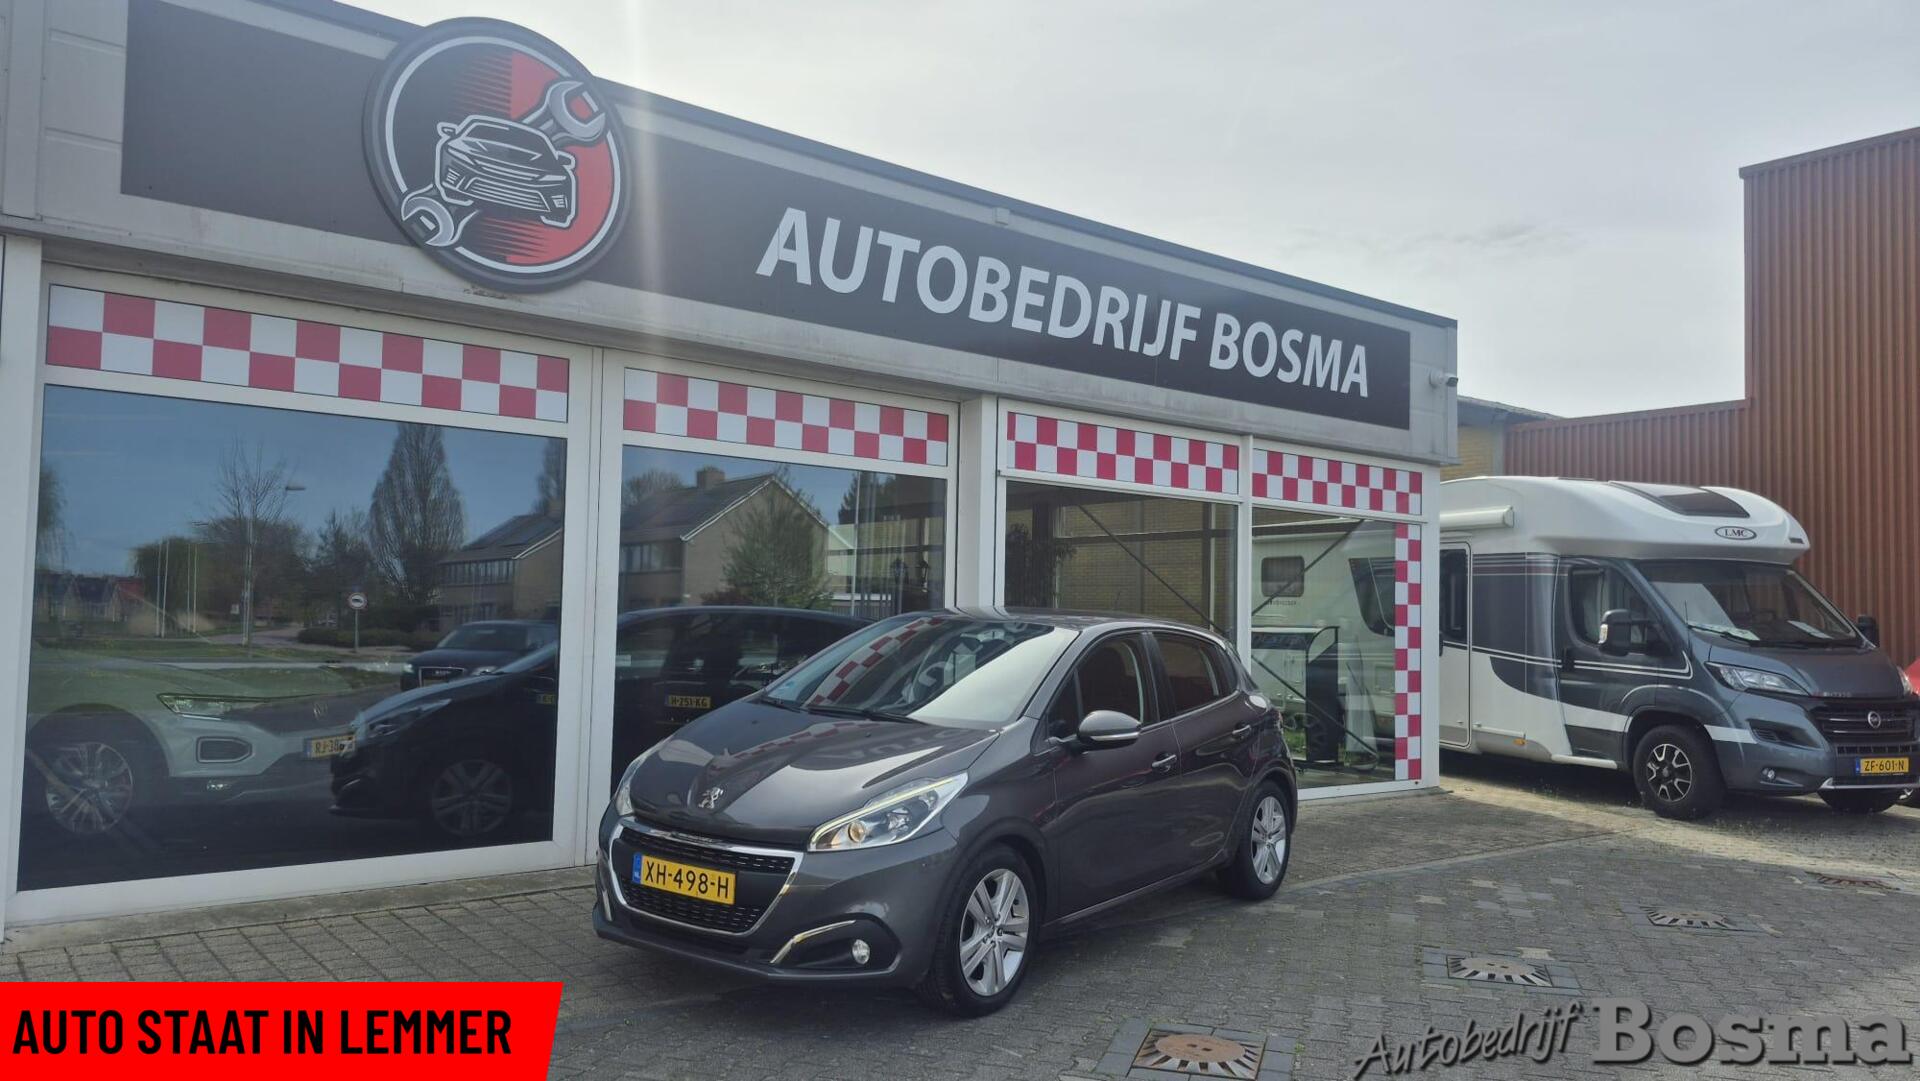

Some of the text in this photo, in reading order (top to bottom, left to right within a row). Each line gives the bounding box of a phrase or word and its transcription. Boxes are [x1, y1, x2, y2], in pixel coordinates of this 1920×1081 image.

[756, 207, 1370, 398] AUTOBEDRIJF BOSMA
[1724, 529, 1747, 537] LMC
[1864, 760, 1905, 772] ZF-601-N
[645, 861, 729, 899] XH-498-H
